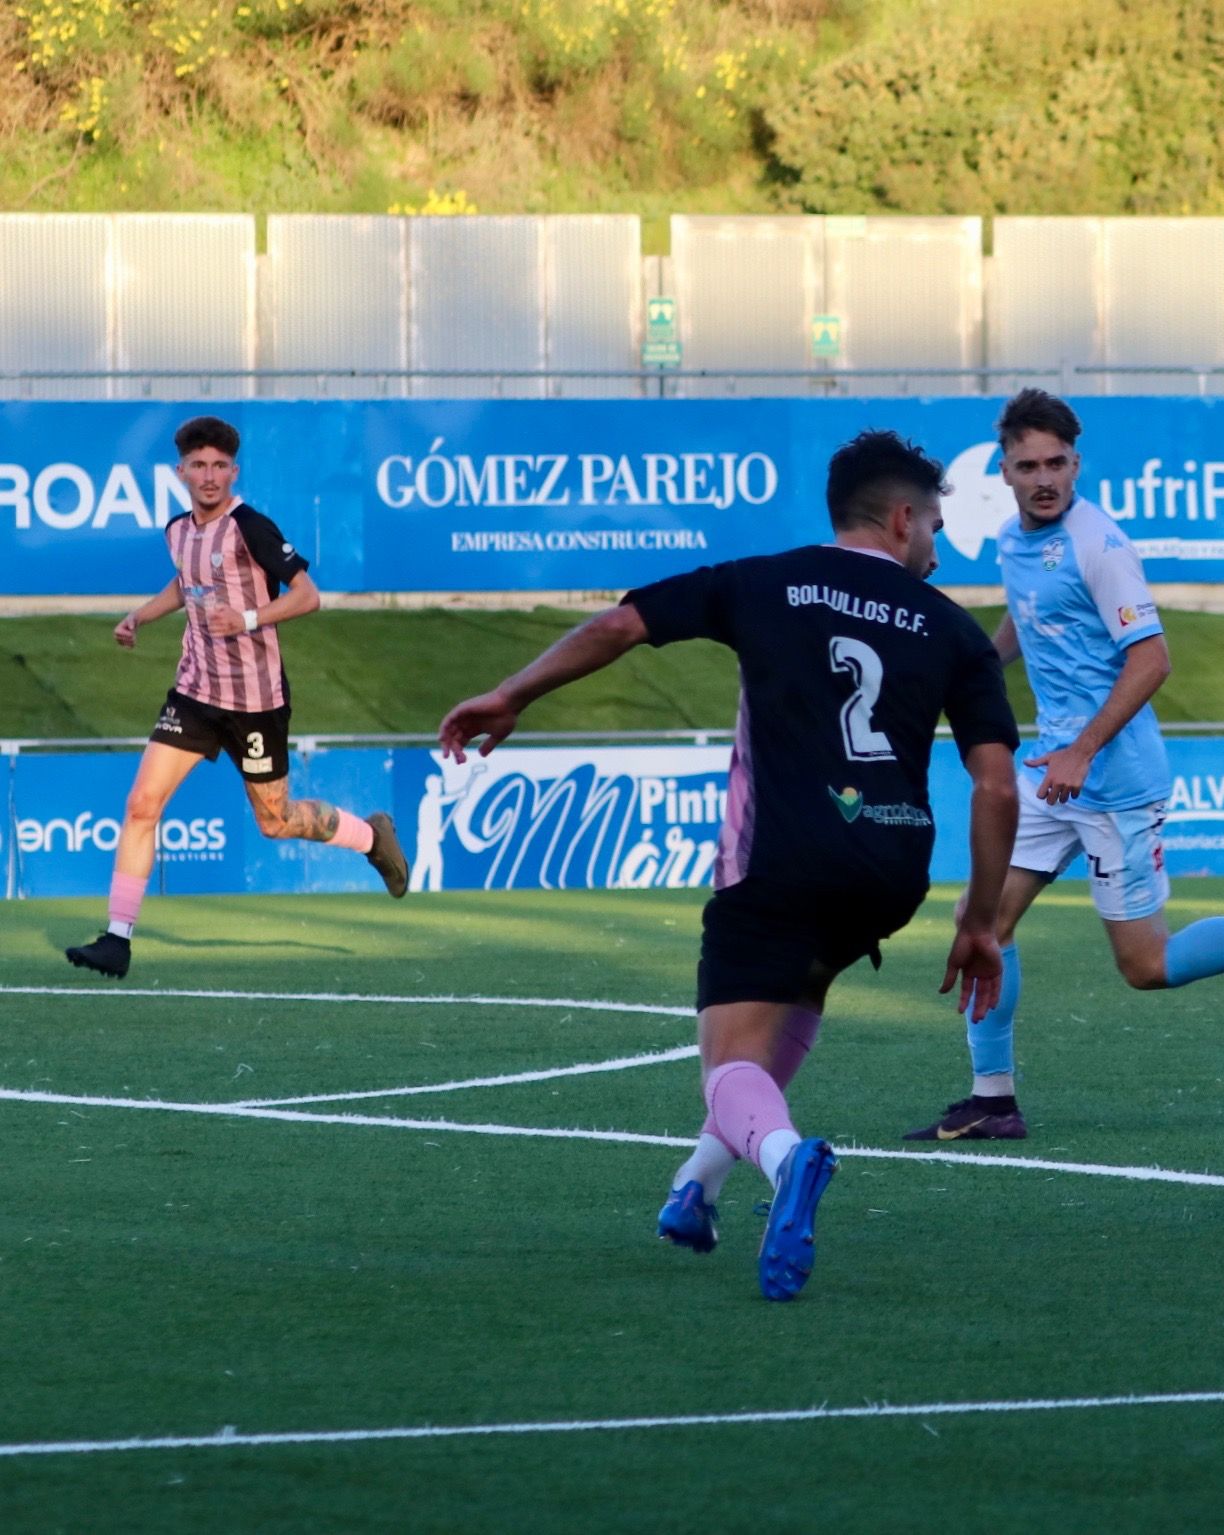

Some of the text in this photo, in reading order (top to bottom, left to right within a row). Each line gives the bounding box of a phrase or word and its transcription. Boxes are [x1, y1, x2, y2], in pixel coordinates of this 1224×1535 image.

[376, 437, 778, 510] GÓMEZ PAREJO
[451, 529, 708, 553] EMPRESA CONSTRUCTORA
[786, 584, 930, 637] BOLLULLOS C.F.
[828, 635, 898, 763] 2
[246, 731, 265, 759] 3
[17, 811, 227, 853] enfolass
